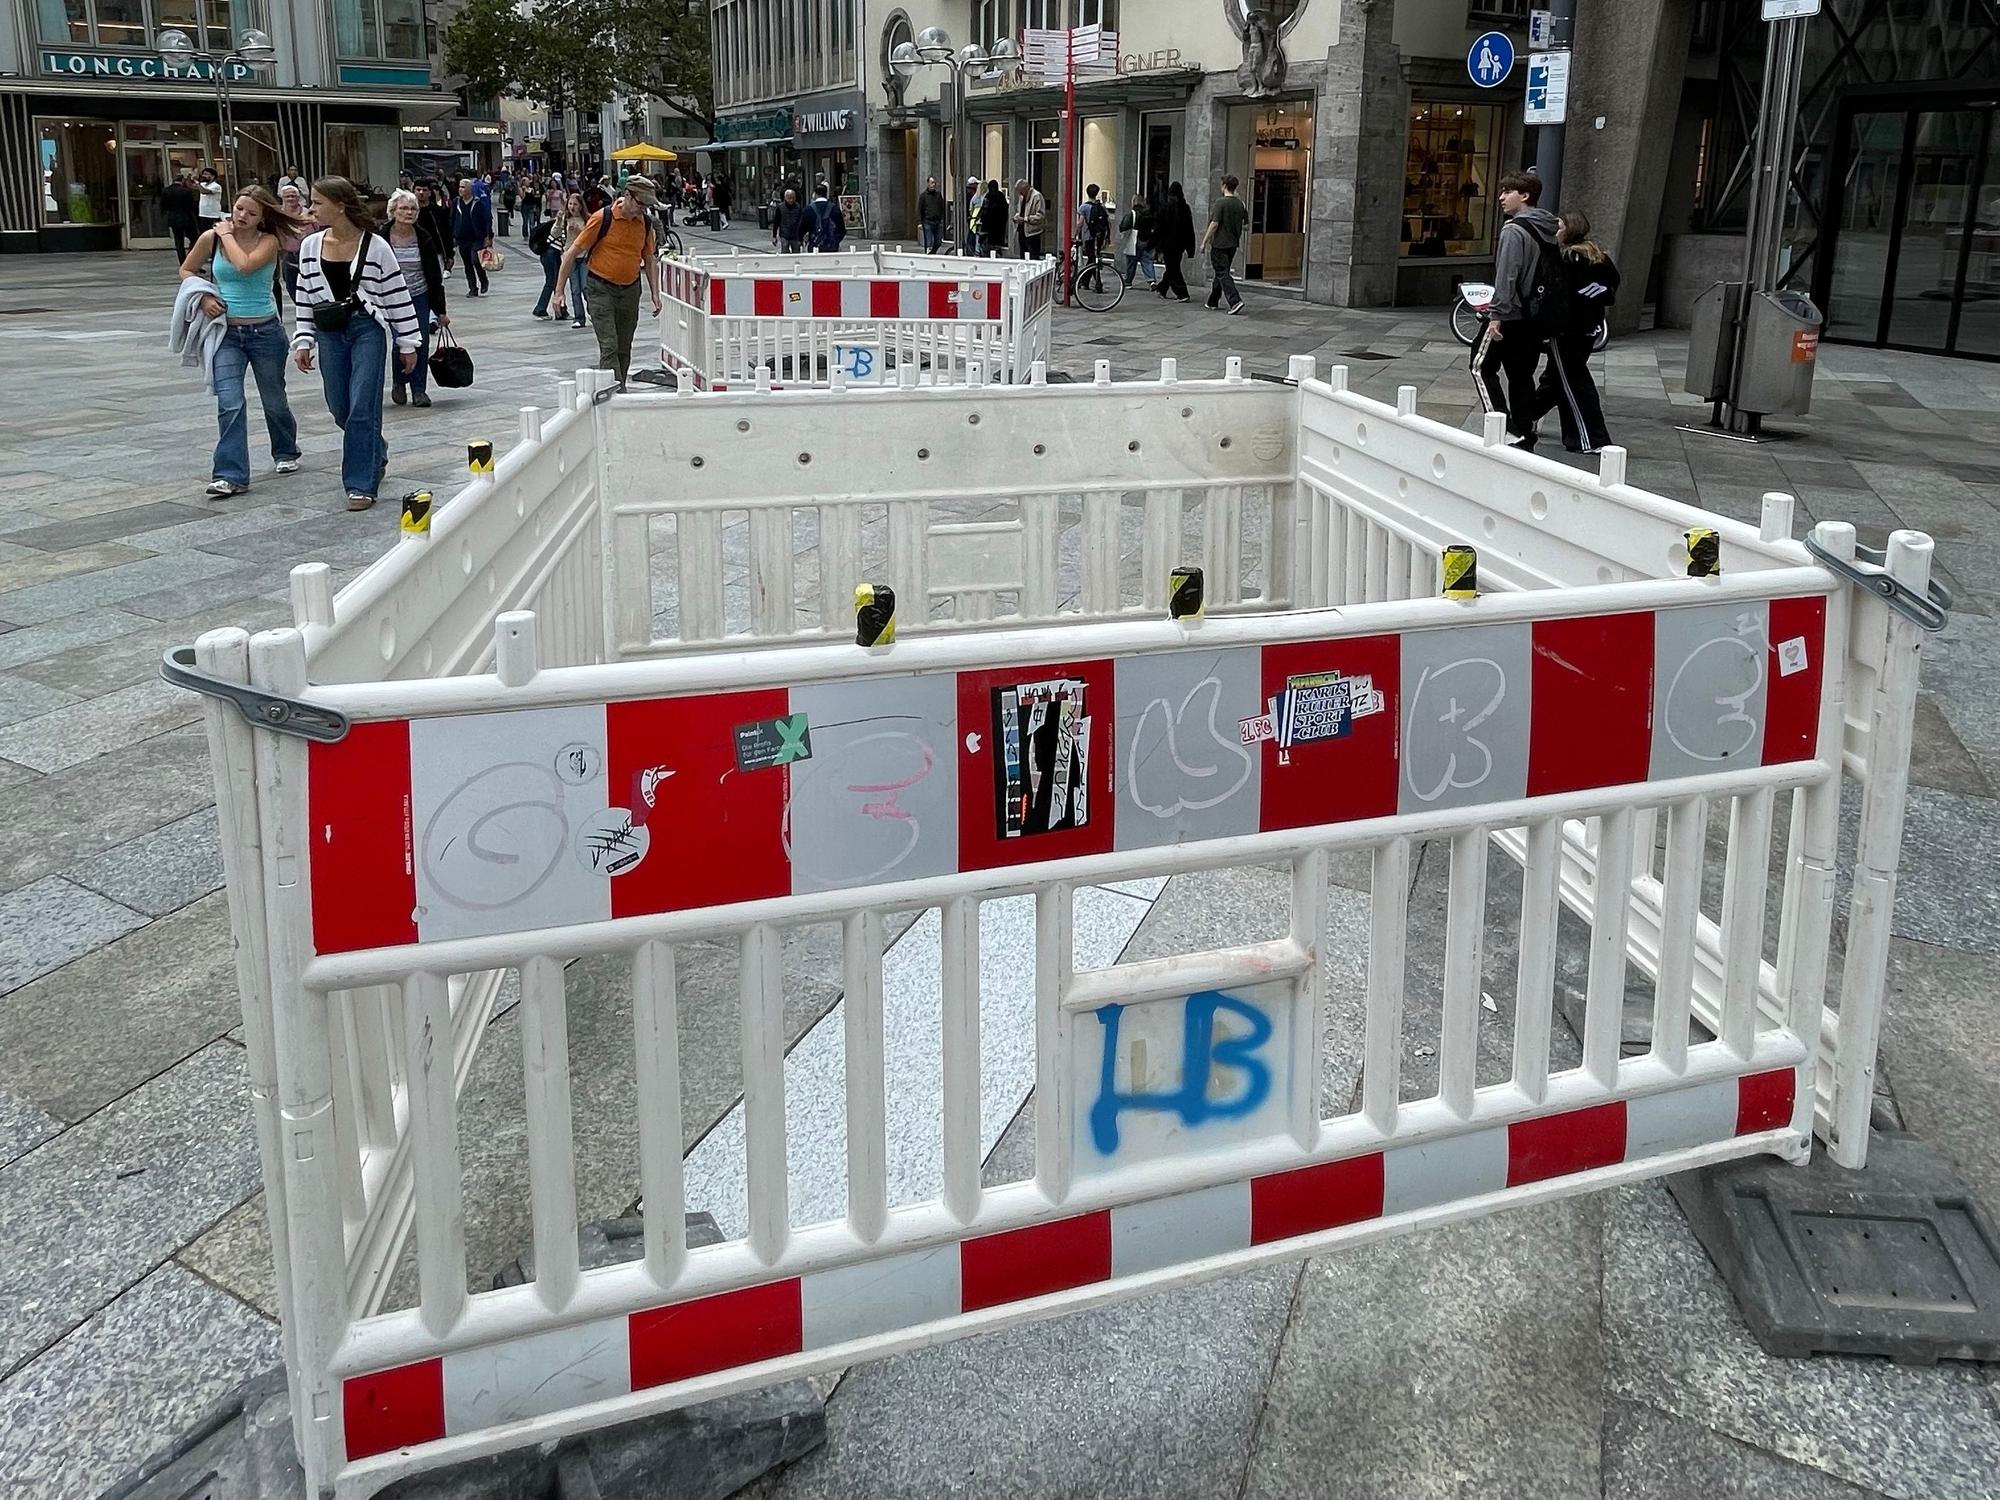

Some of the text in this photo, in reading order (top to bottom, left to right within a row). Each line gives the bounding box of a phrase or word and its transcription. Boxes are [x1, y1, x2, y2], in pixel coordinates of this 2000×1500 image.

[50, 55, 247, 80] LONGCHAMP
[1119, 48, 1182, 73] IGNER
[801, 110, 849, 133] ZWILLING
[1296, 682, 1349, 703] KARLS
[1295, 696, 1350, 715] RUHER
[1293, 709, 1345, 728] SPORT
